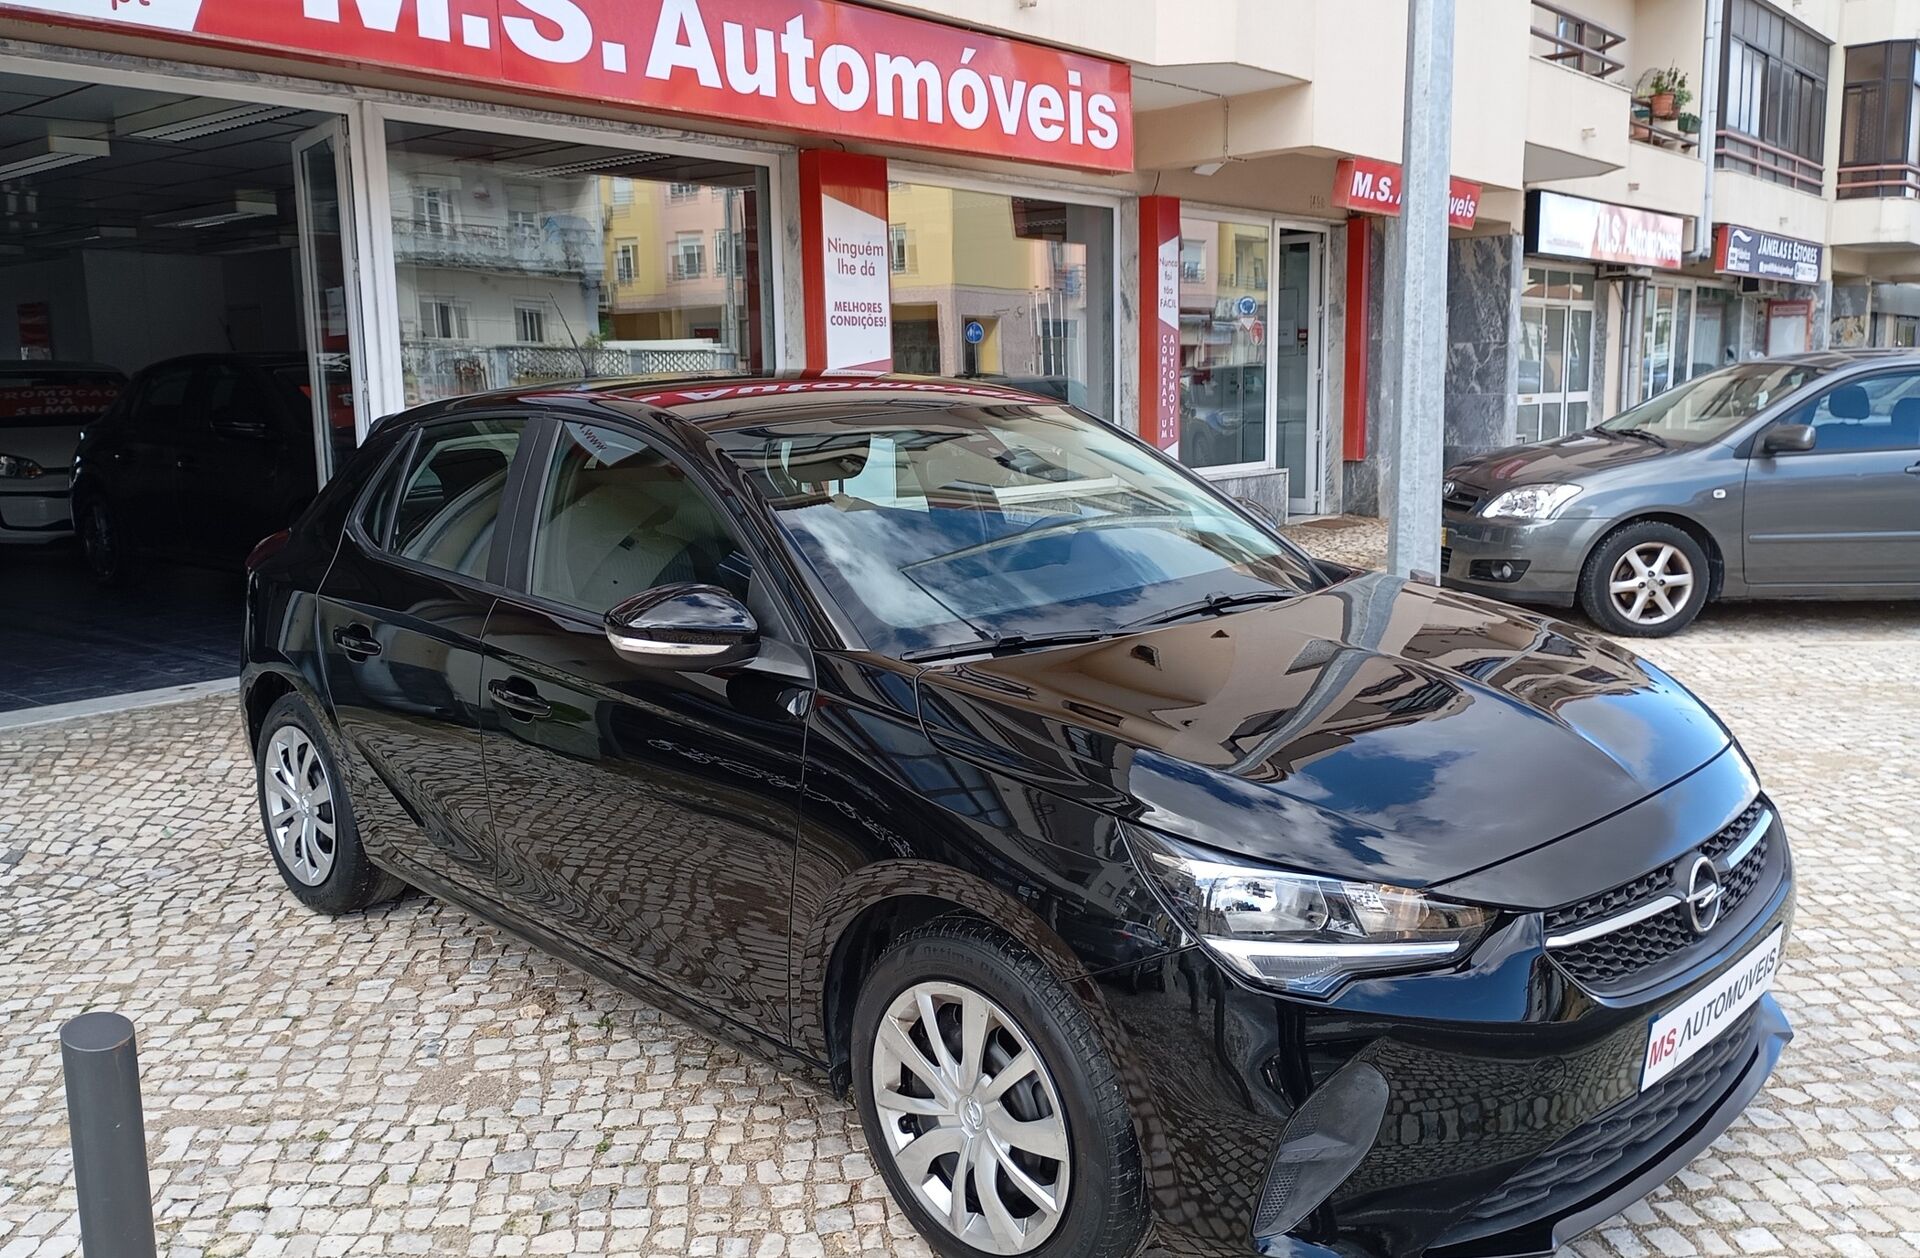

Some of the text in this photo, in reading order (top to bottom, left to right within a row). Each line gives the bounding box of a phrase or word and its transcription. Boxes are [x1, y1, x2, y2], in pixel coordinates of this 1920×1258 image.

[644, 0, 1119, 150] Automóveis
[1352, 170, 1394, 203] M.S.
[828, 237, 884, 259] Ninguém
[837, 258, 876, 277] lhe dá
[834, 301, 883, 314] MELHORES
[830, 313, 887, 330] CONDIÇÕES!
[1161, 419, 1168, 438] UM
[1648, 947, 1777, 1069] MS AUTOMOVEIS
